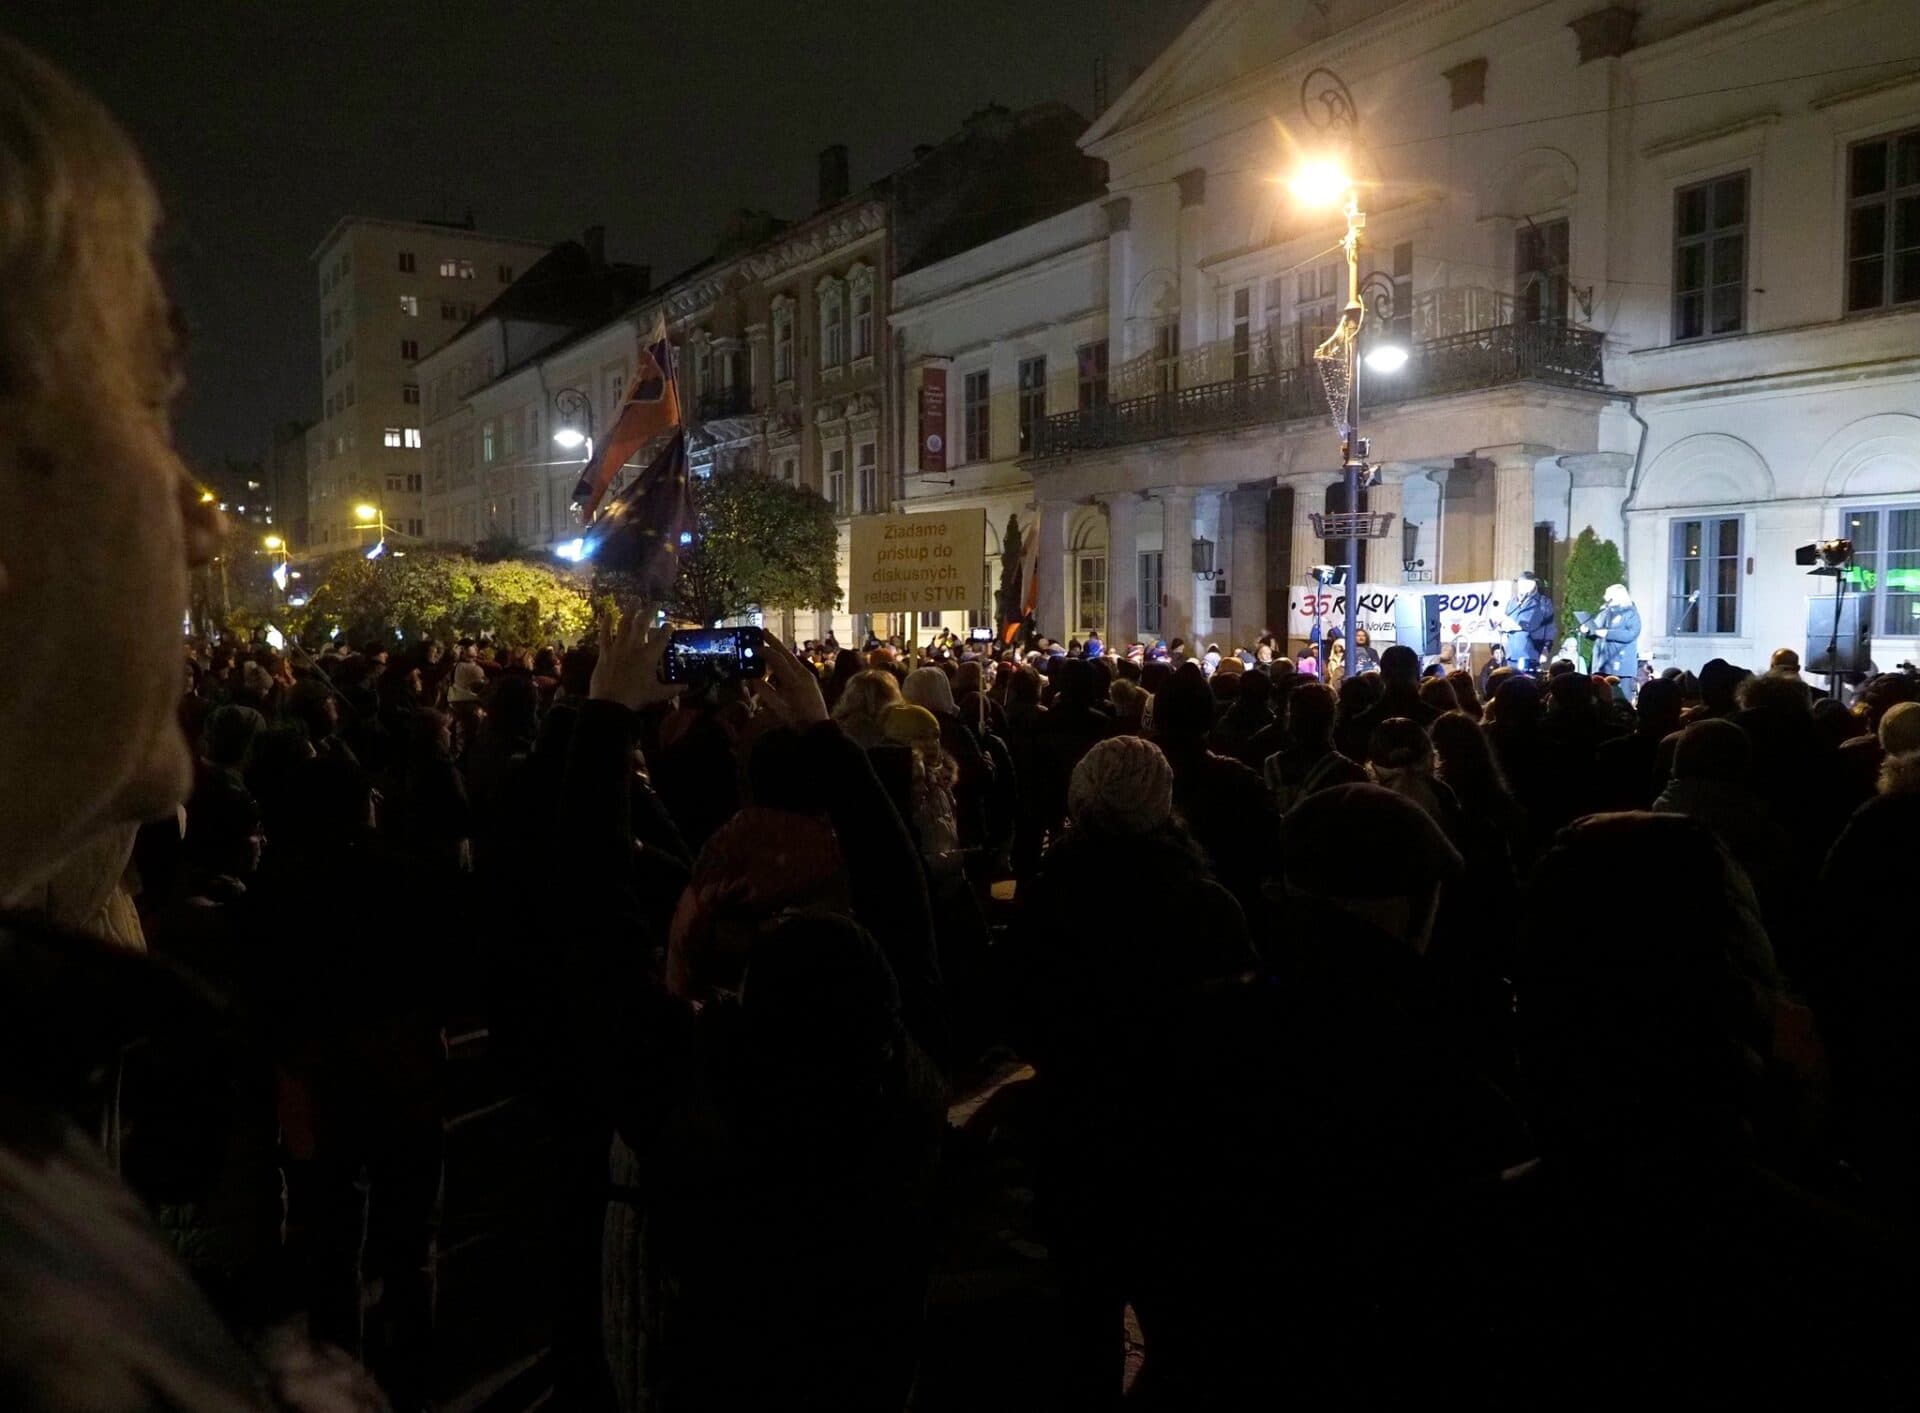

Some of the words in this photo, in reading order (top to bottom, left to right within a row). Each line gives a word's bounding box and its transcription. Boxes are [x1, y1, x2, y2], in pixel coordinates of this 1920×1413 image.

[933, 544, 953, 558] do
[911, 591, 920, 602] v
[924, 586, 966, 602] STVR
[1300, 594, 1332, 616] 35
[1332, 593, 1398, 615] RKOV
[1439, 592, 1493, 616] BODY
